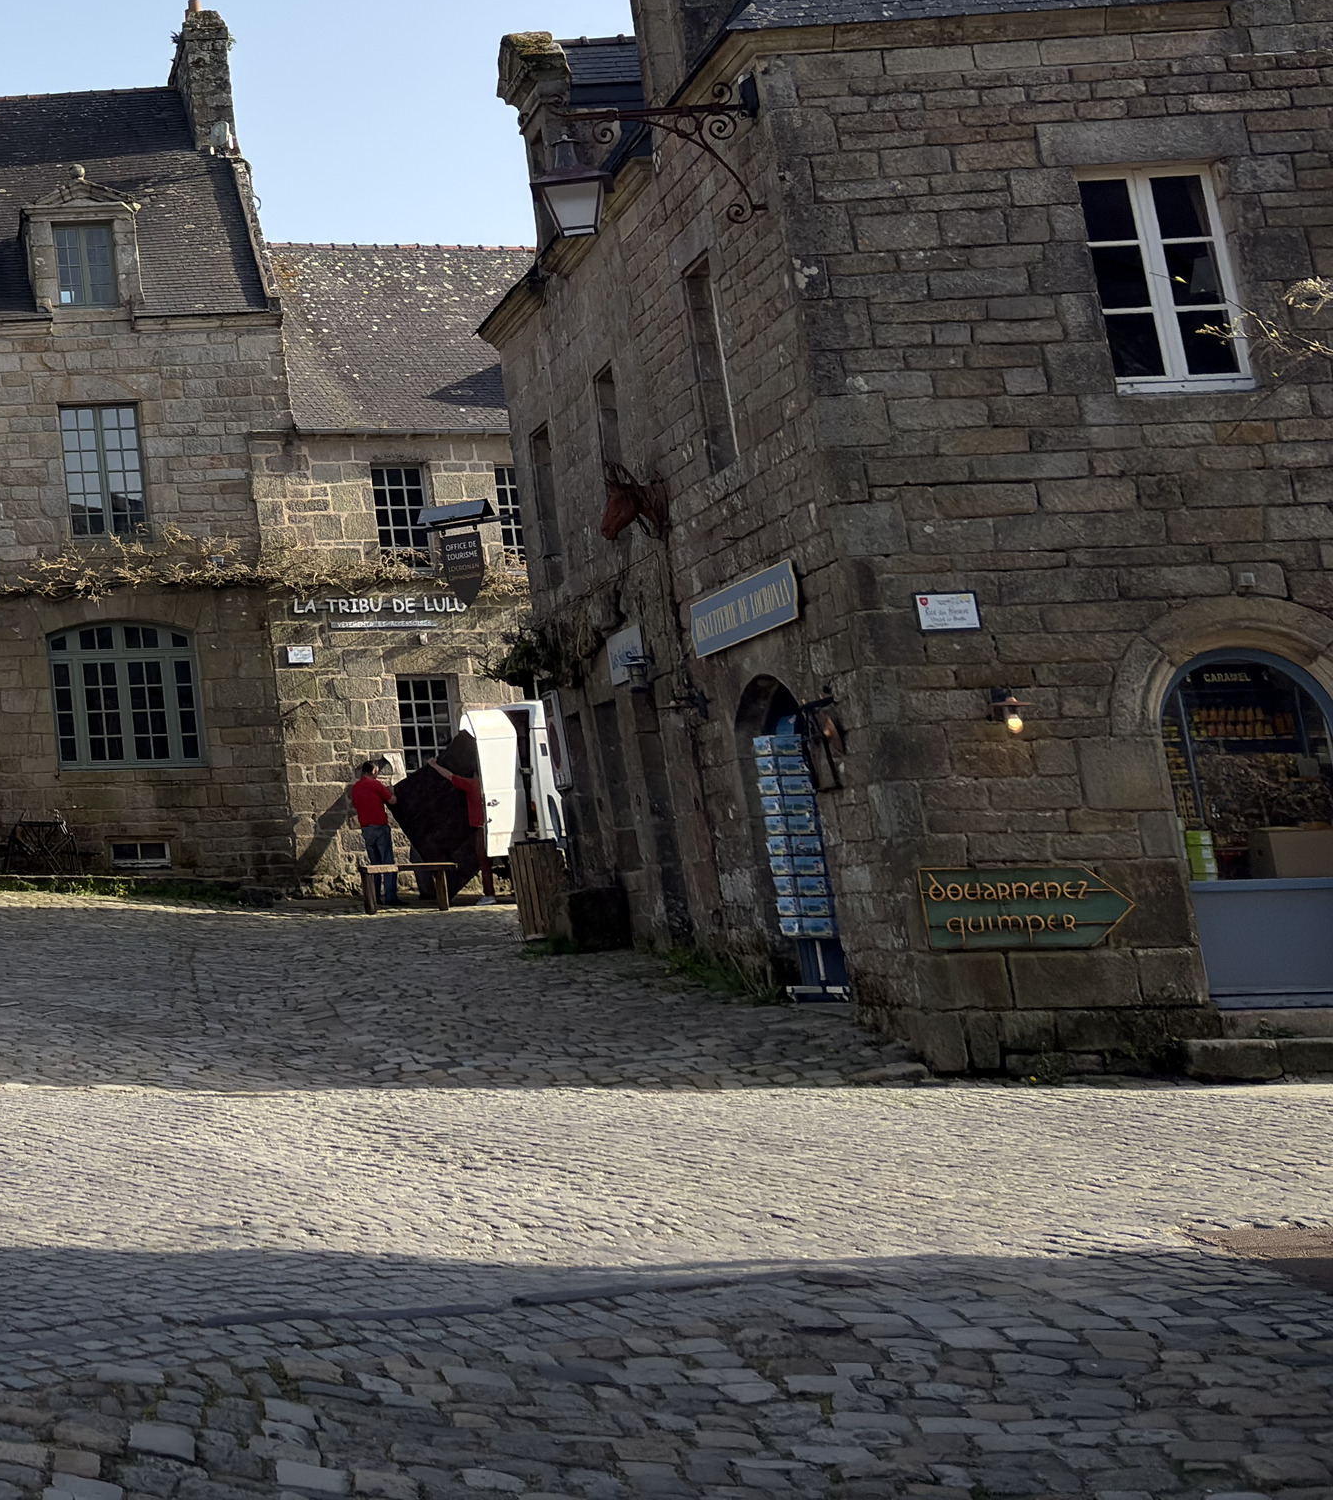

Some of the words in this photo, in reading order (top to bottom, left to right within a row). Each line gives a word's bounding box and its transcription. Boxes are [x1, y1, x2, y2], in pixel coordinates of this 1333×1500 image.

[445, 541, 467, 552] OFFICE
[468, 540, 477, 548] DE
[446, 550, 478, 561] TOURISME
[293, 598, 316, 614] LA
[325, 597, 383, 614] TRIBU
[392, 597, 416, 614] DE
[424, 596, 467, 613] LULU
